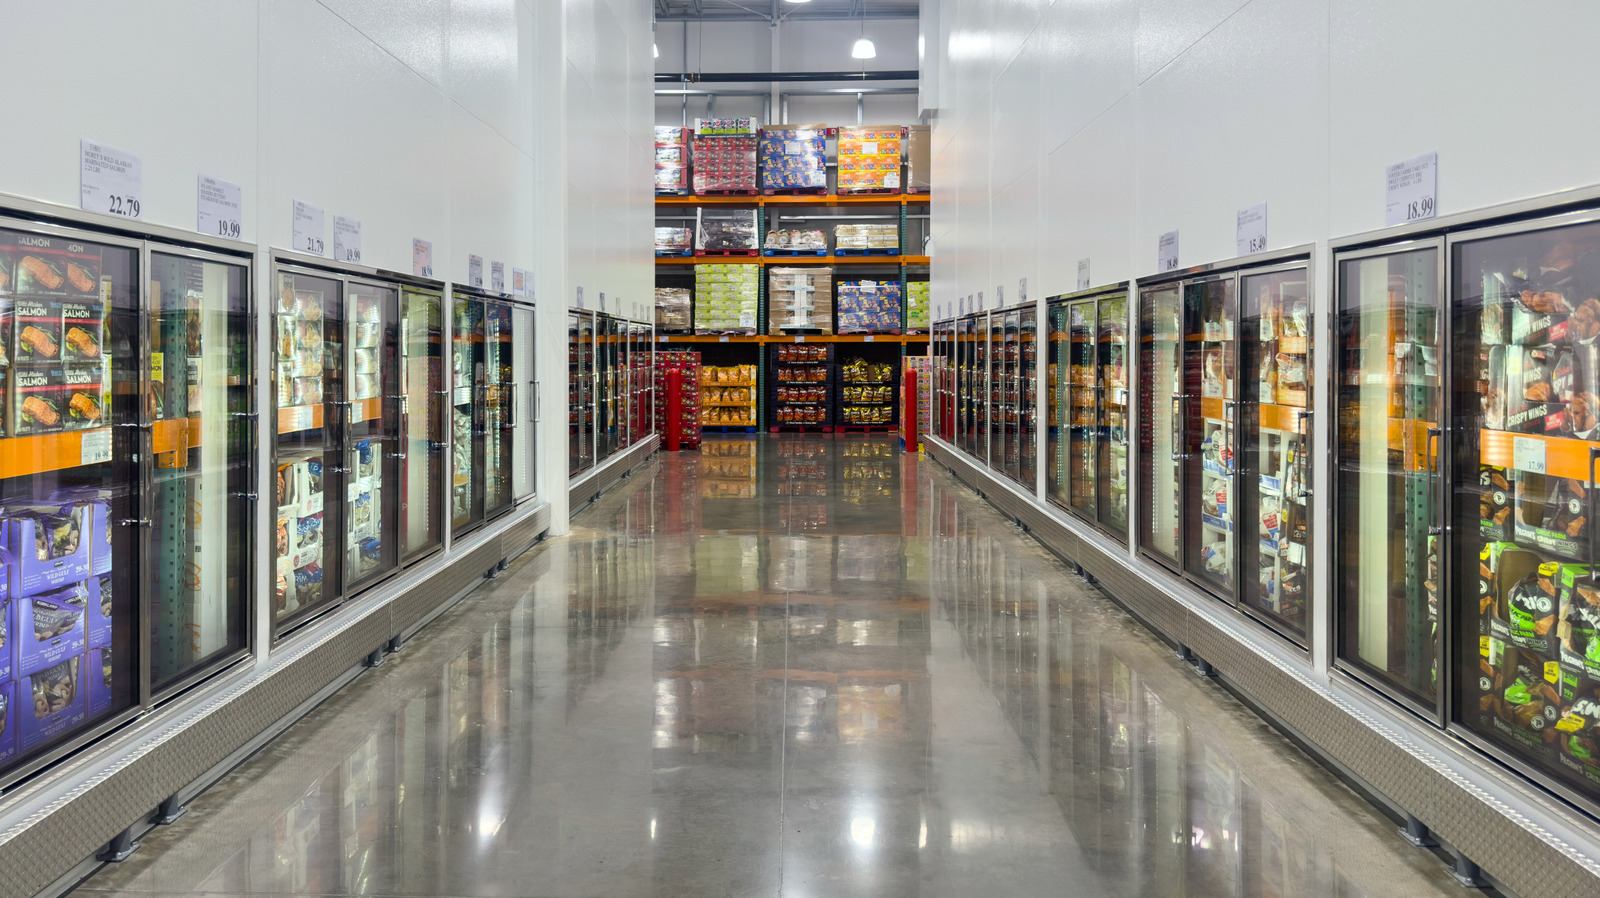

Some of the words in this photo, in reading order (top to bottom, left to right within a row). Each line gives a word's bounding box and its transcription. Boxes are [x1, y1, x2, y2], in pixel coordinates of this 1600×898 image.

[109, 195, 140, 217] 22.79
[1407, 198, 1433, 220] 18.99
[219, 220, 240, 238] 19.99
[308, 237, 324, 253] 21.79
[1250, 236, 1265, 253] 15.49
[347, 248, 360, 262] 19.99
[18, 307, 47, 316] SALMON
[64, 310, 90, 318] SALMON
[18, 377, 48, 386] SALMON
[67, 375, 92, 384] SALMON
[1508, 412, 1528, 427] CRISPY
[1528, 404, 1547, 420] WINGS
[95, 451, 108, 460] 19.99
[1529, 461, 1544, 471] 17.99
